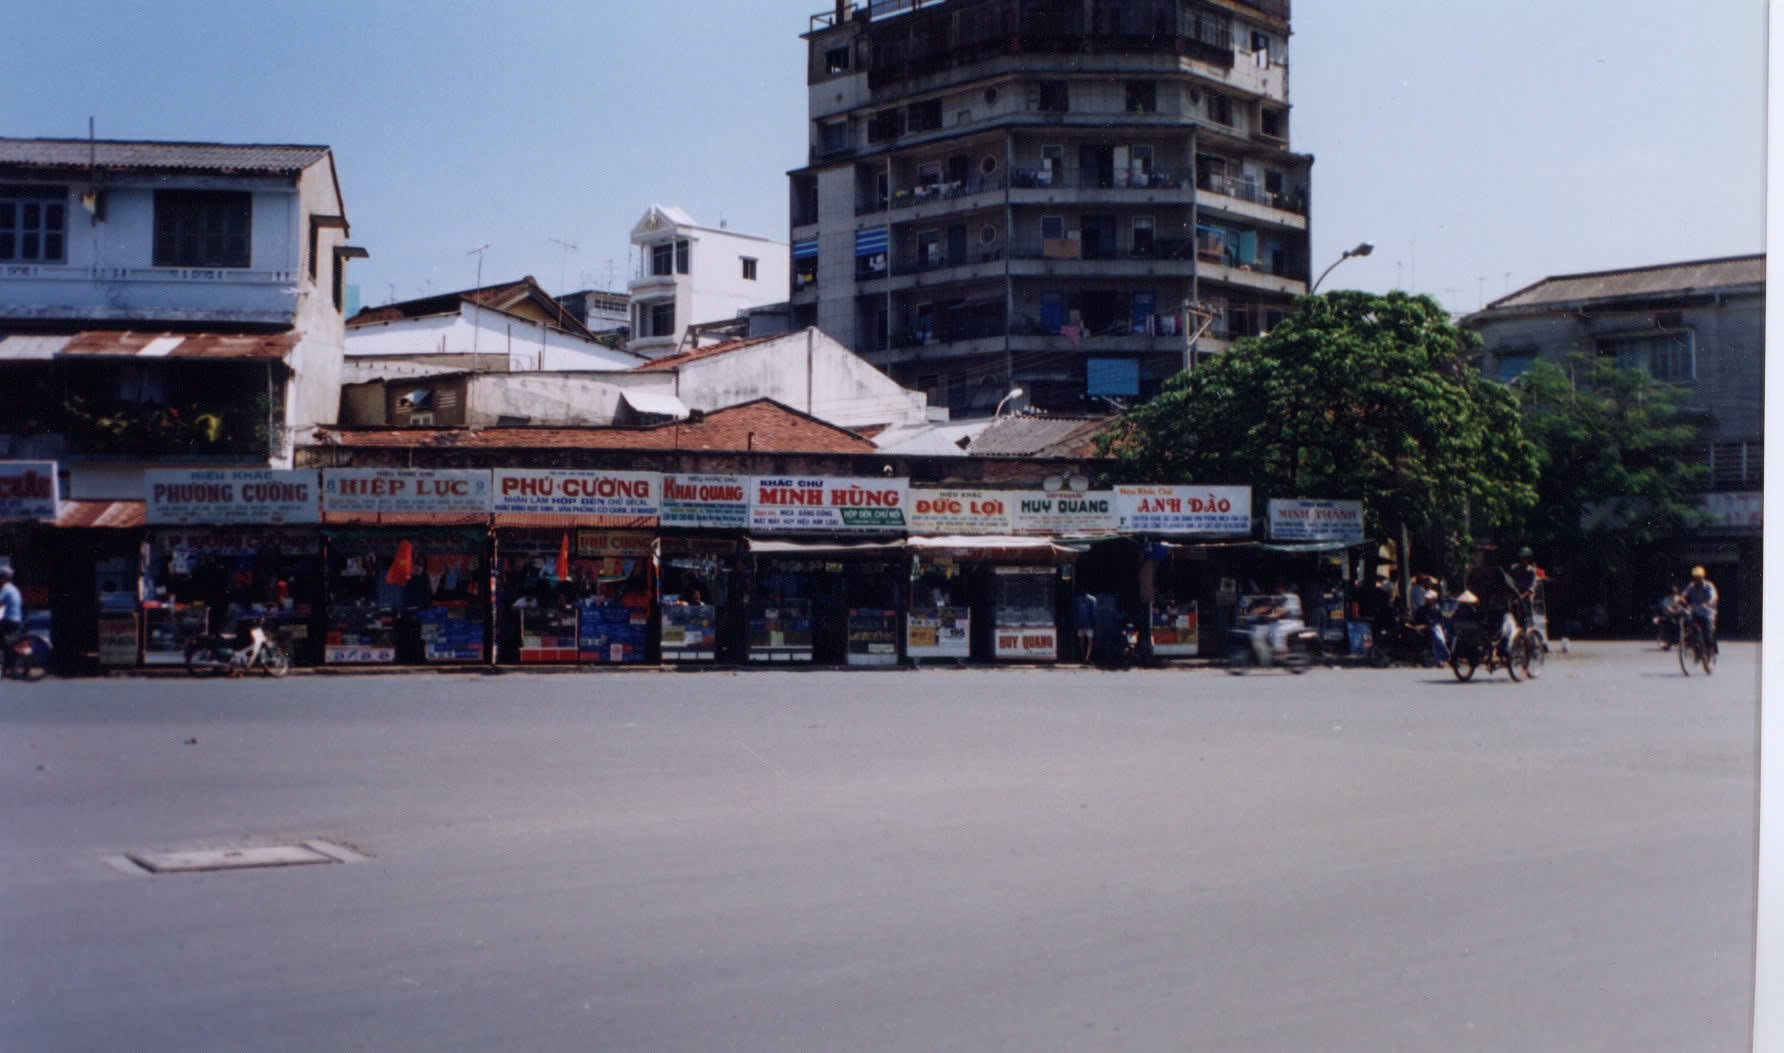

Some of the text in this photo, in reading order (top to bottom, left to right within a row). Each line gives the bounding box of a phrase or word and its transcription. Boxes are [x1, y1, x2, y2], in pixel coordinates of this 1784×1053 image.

[663, 477, 744, 501] KHAI QUANG
[759, 484, 900, 506] MINH HÙNG
[916, 498, 1004, 517] ĐỨC LỢI
[1021, 499, 1109, 513] HUY QUANG
[1137, 492, 1231, 513] ANH ĐÀO
[999, 635, 1053, 650] HUY QUANG
